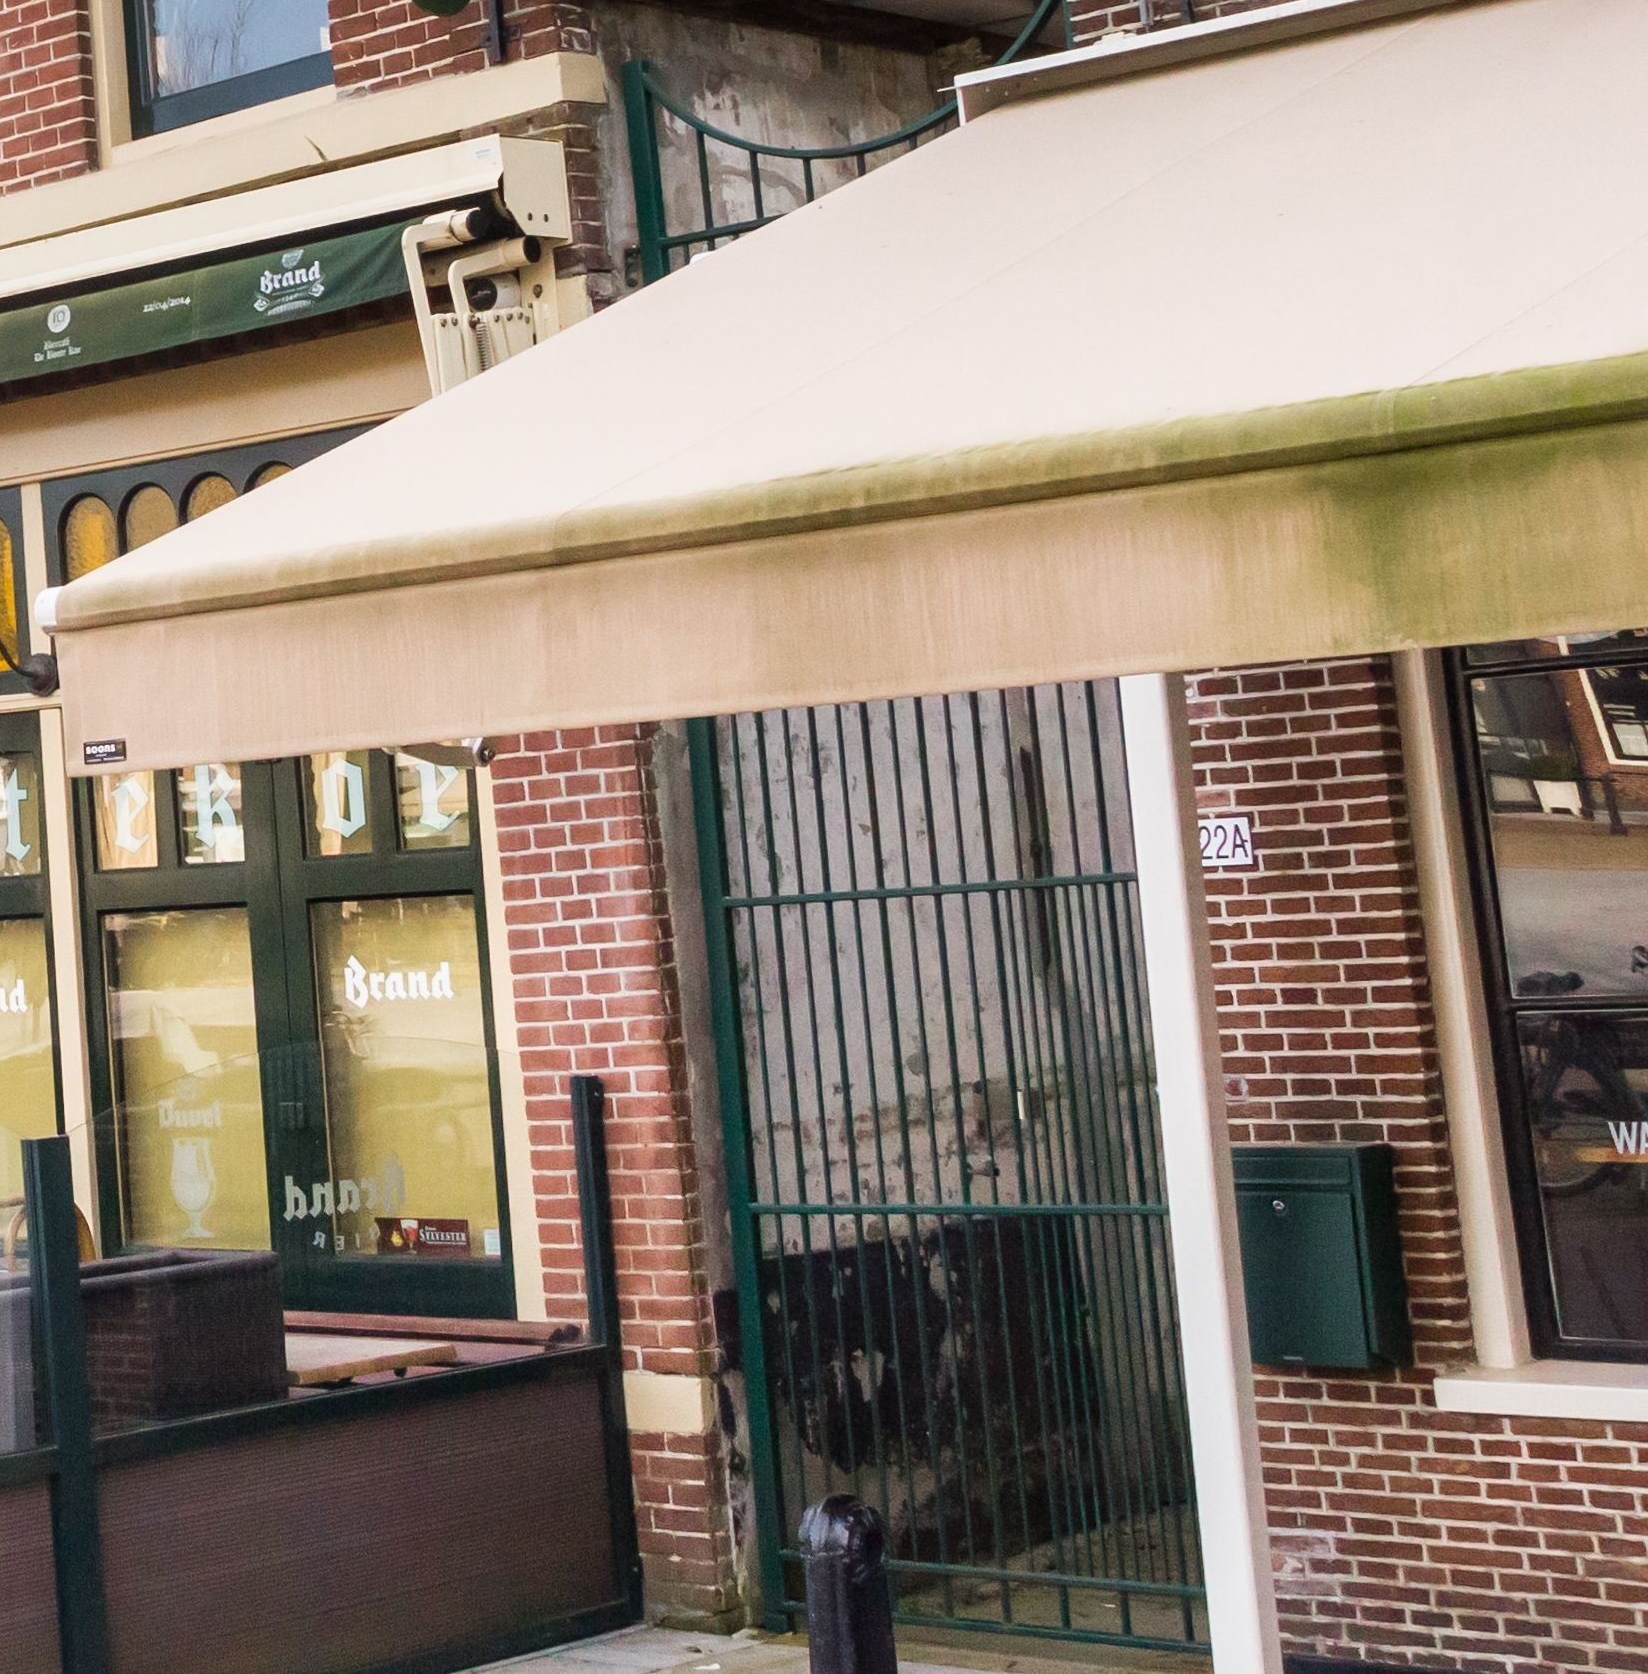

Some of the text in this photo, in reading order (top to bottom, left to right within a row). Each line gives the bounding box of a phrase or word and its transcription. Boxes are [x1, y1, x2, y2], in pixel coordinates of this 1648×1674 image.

[260, 260, 321, 294] Brand
[1199, 824, 1249, 859] 22A
[343, 954, 455, 1008] Brand
